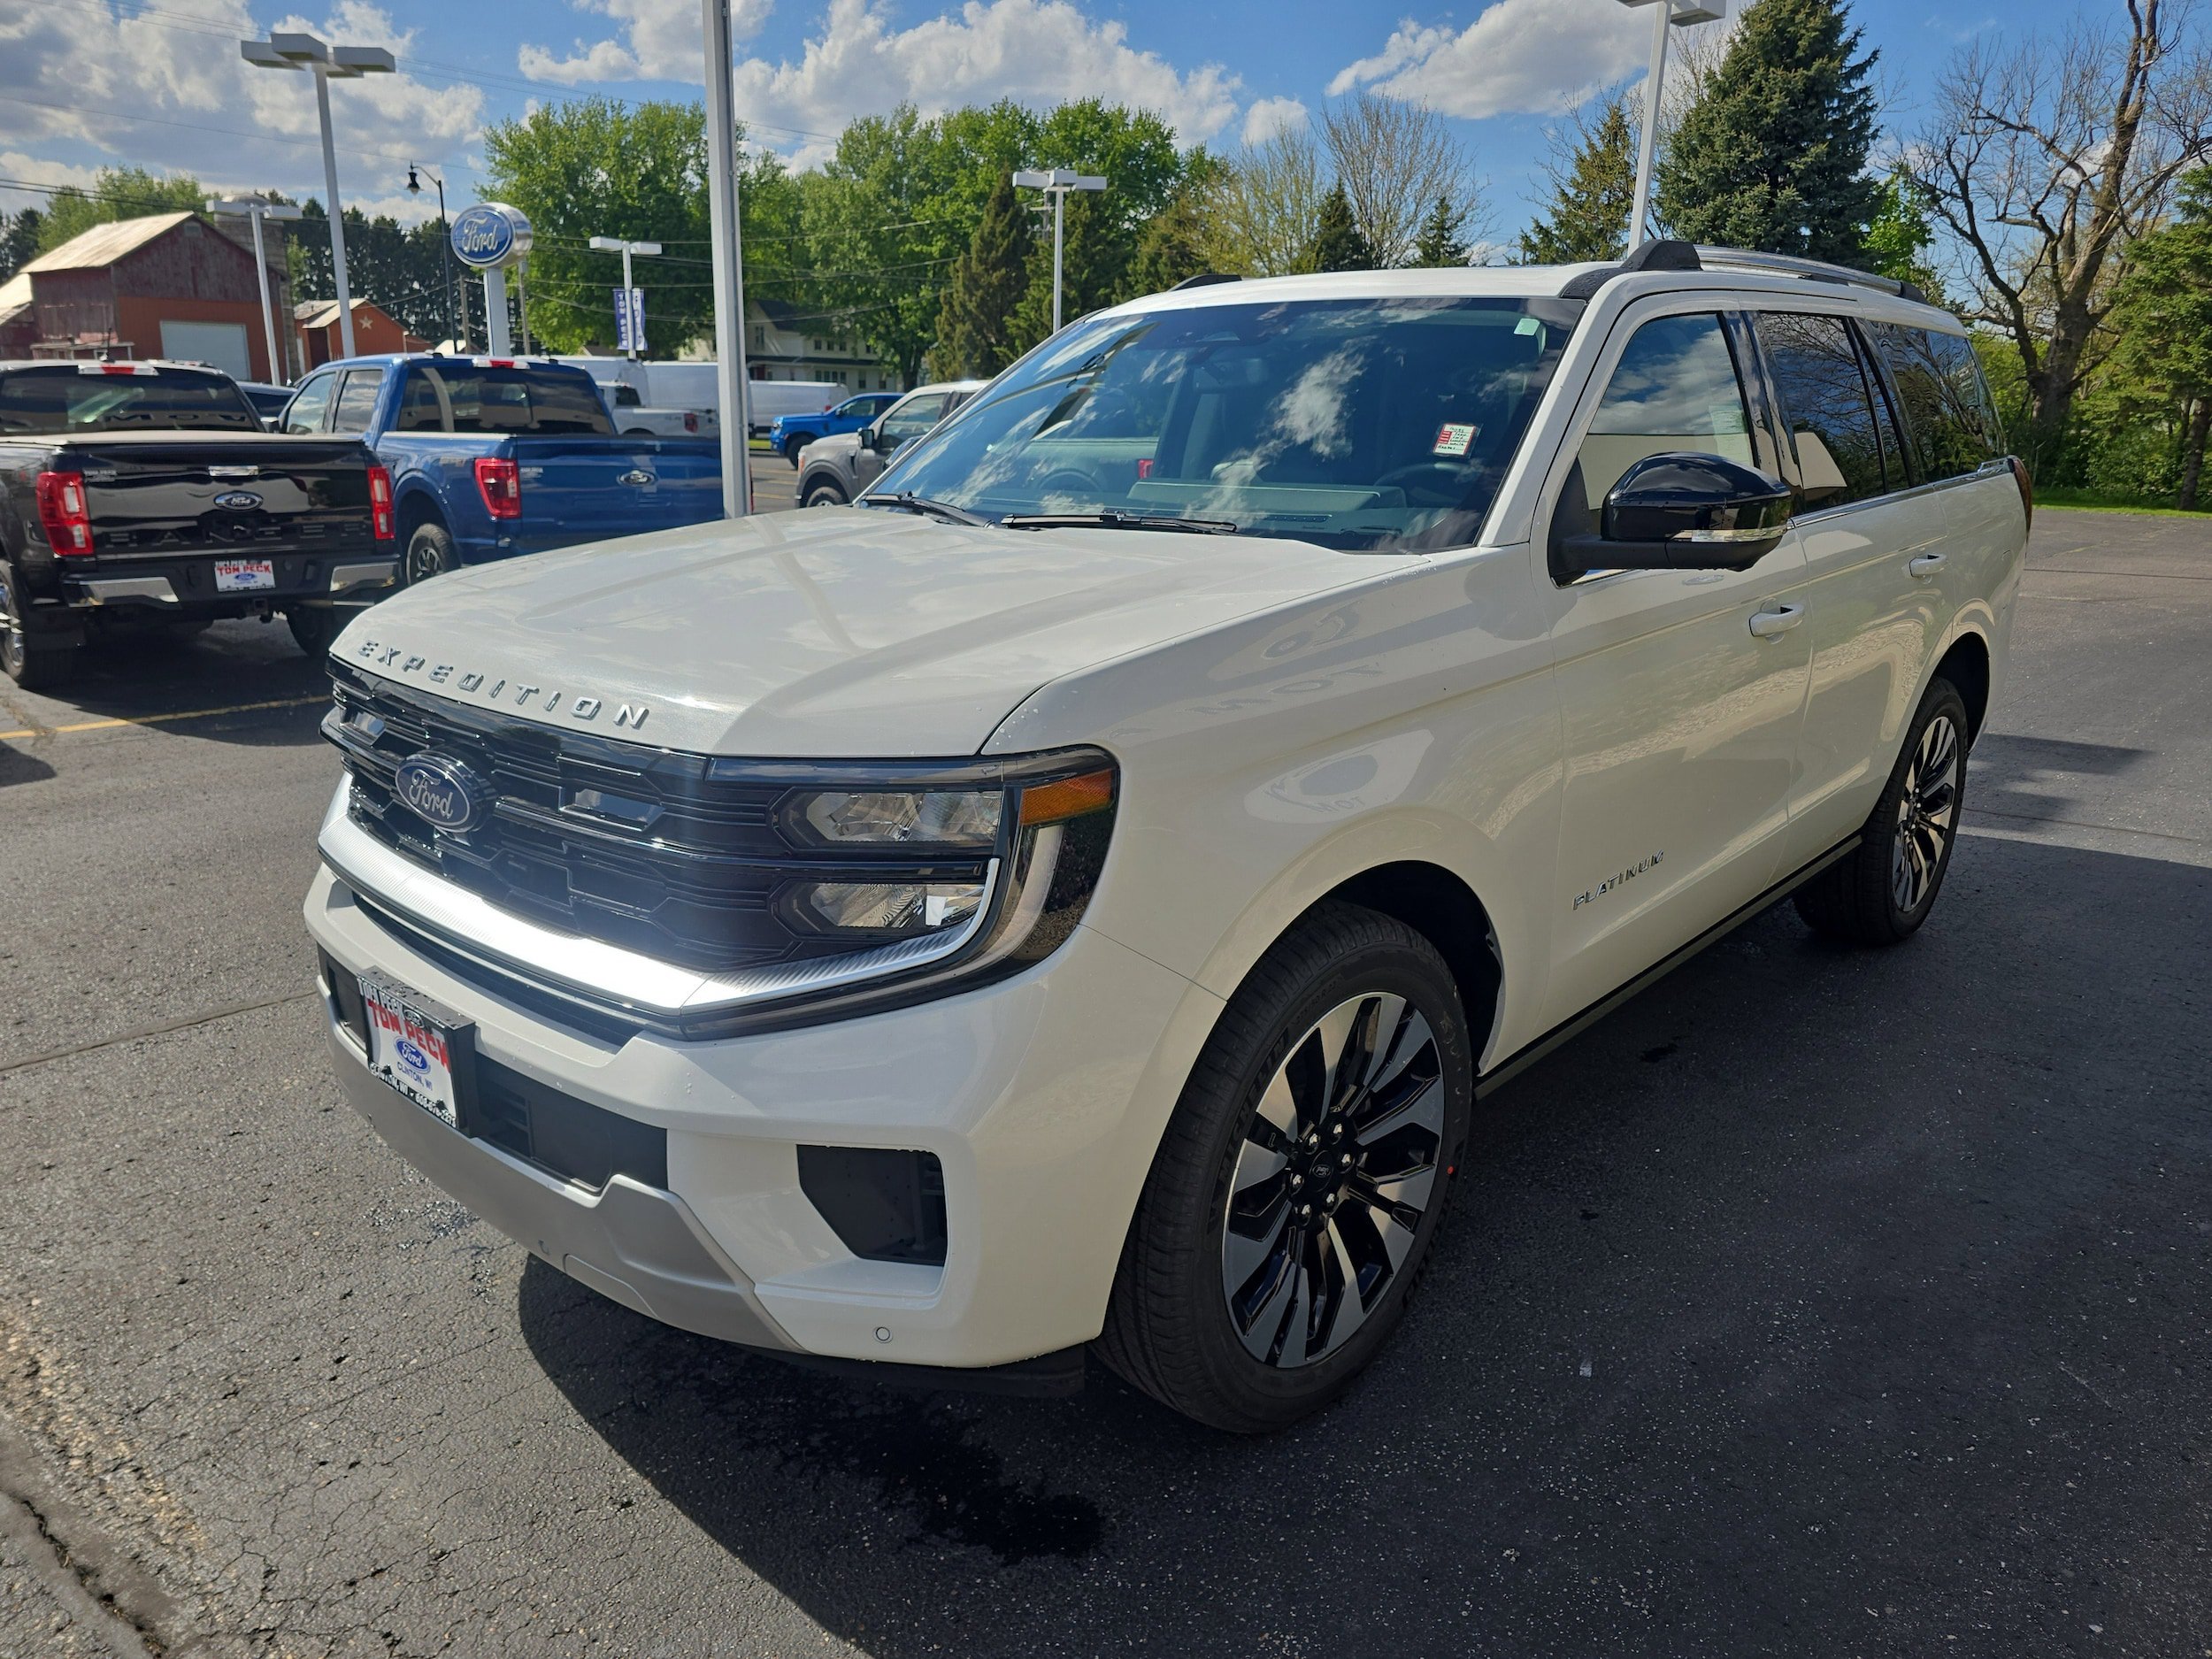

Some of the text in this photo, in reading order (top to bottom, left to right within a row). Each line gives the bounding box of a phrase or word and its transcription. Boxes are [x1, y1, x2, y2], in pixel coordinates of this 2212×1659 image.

[461, 217, 499, 254] Ford
[218, 565, 240, 577] TOM
[243, 563, 272, 574] PECK
[357, 640, 650, 729] EXPEDITION
[408, 769, 454, 819] Ford
[1572, 849, 1663, 910] PLATINUM
[368, 998, 451, 1075] TOM PECK
[402, 1042, 423, 1068] Ford
